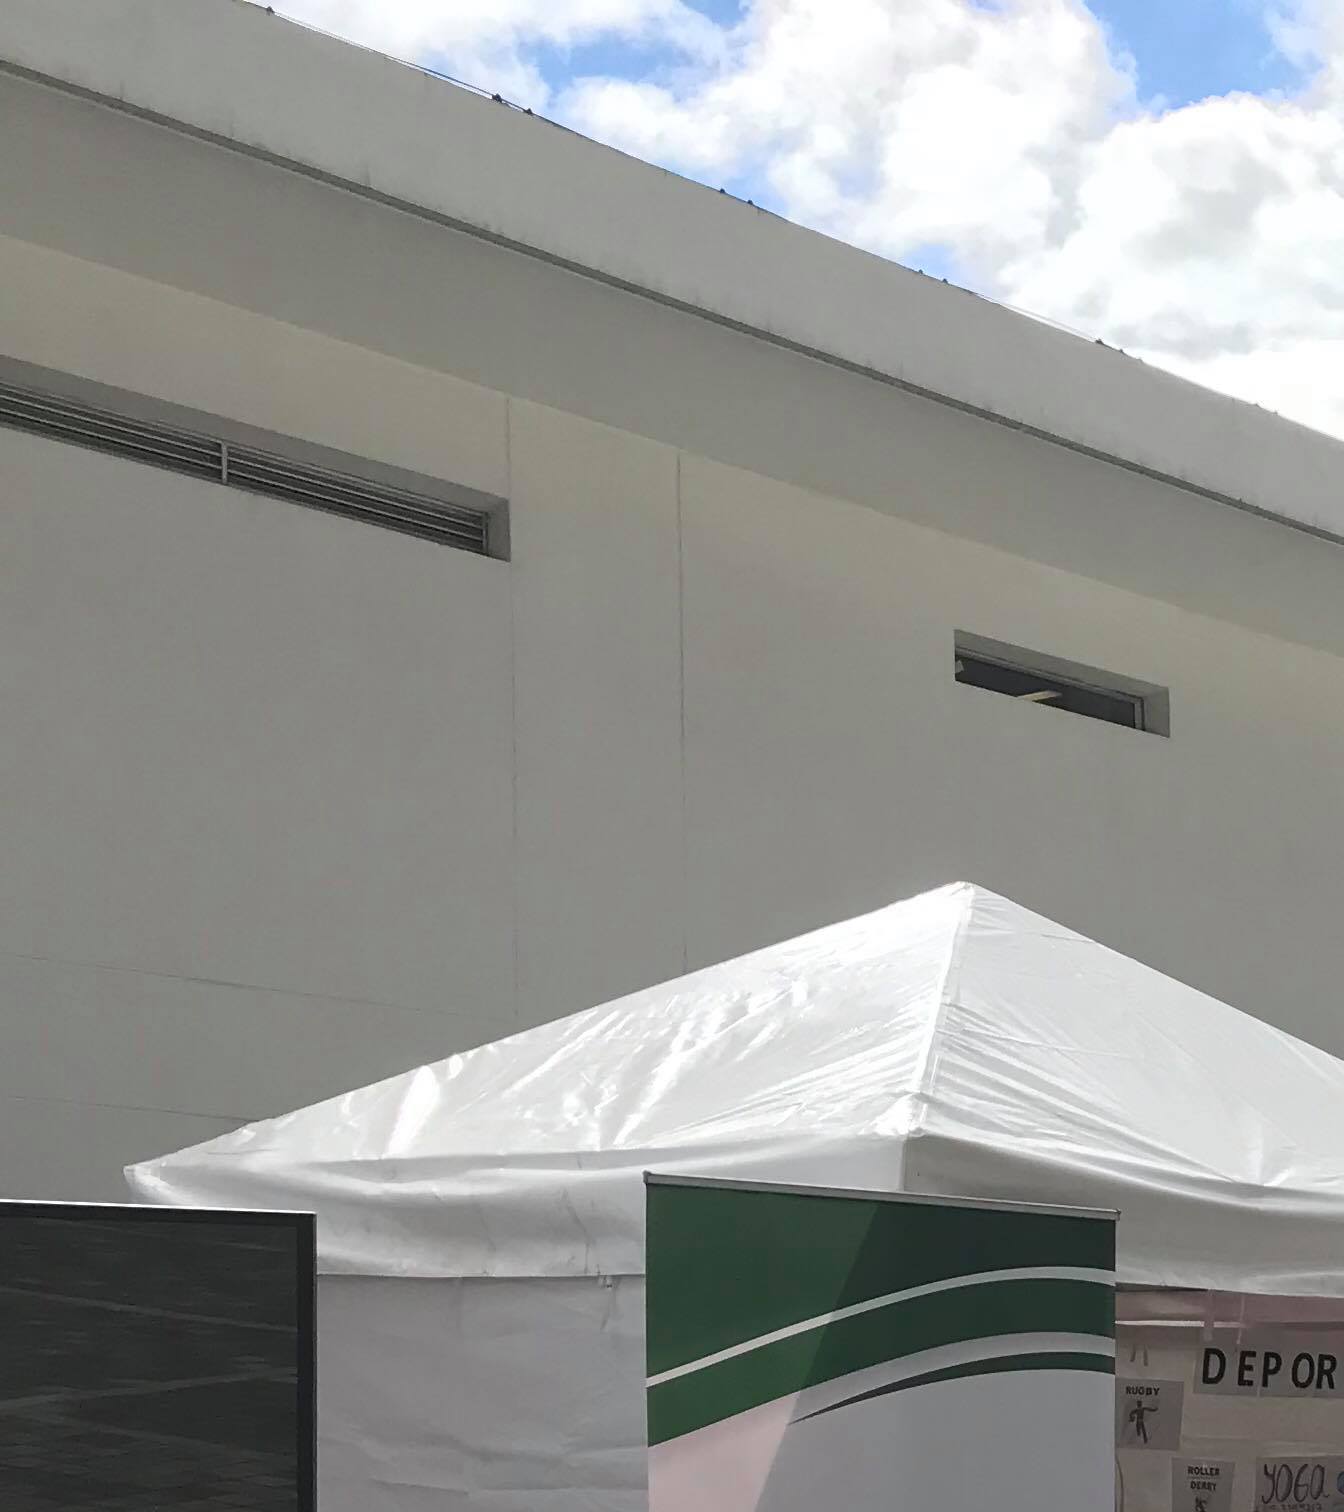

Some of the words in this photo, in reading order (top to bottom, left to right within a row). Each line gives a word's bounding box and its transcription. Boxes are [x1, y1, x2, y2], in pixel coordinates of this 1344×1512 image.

[1126, 1386, 1160, 1396] RUGBY
[1187, 1466, 1220, 1476] ROLLER
[1190, 1481, 1217, 1491] DERBY
